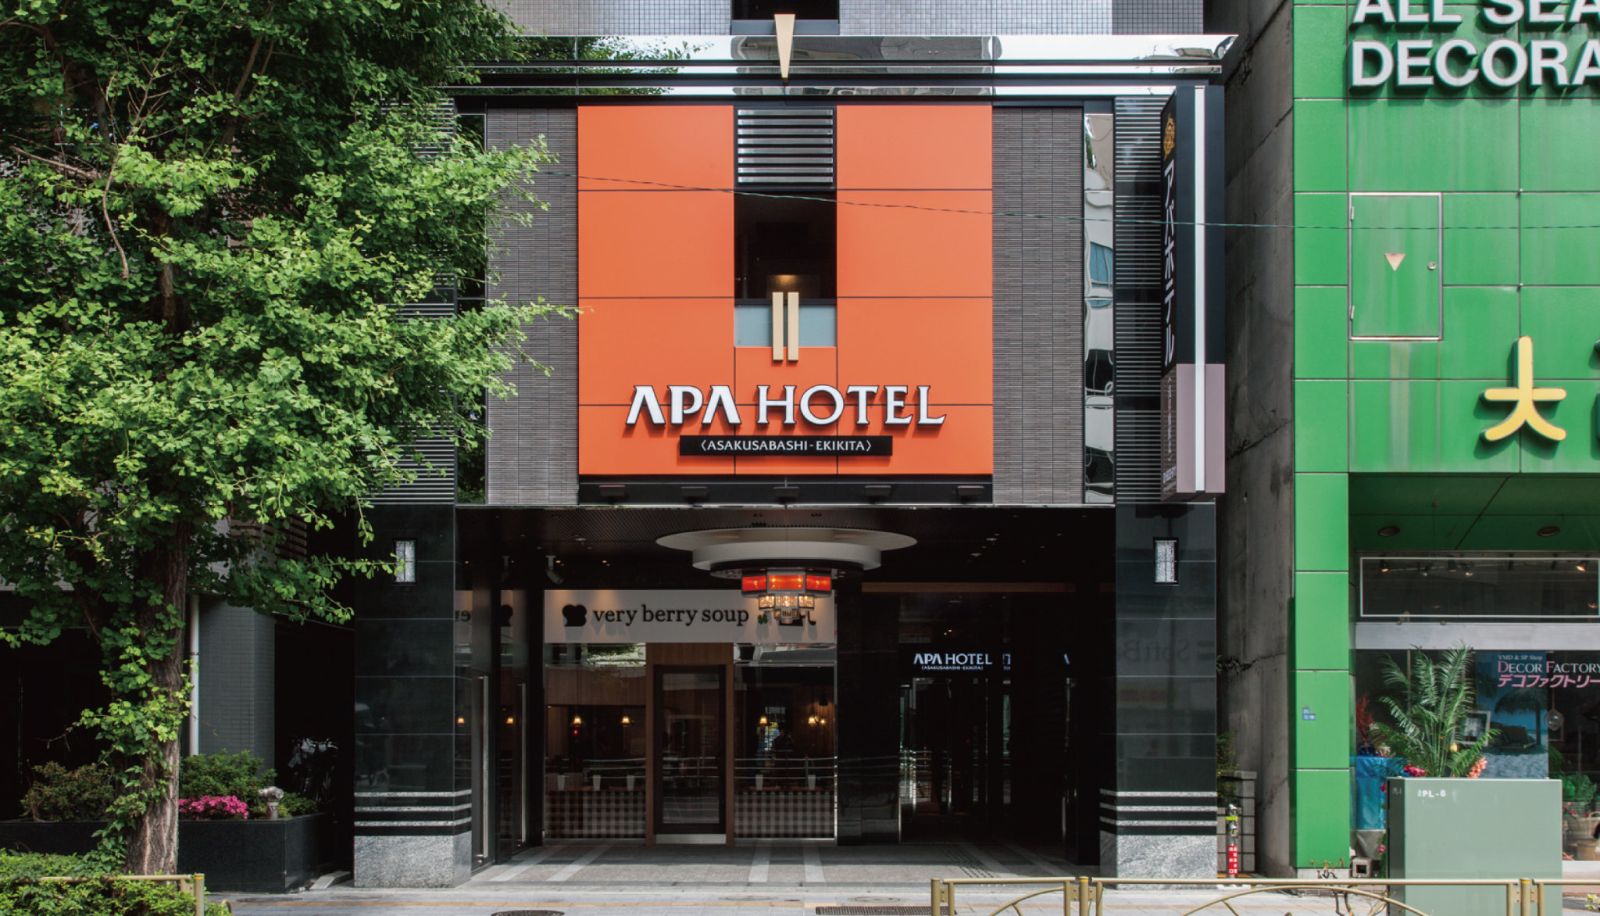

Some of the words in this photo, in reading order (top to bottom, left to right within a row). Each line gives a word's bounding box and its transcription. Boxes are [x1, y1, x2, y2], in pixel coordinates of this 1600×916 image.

[625, 384, 742, 426] APA
[756, 384, 947, 426] HOTEL
[593, 608, 638, 626] very
[642, 604, 698, 626] berry
[701, 609, 749, 626] soup
[913, 653, 943, 665] APA
[945, 653, 993, 665] HOTEL
[1497, 661, 1543, 673] DECOR
[1546, 661, 1600, 673] FACTORY
[1497, 674, 1600, 688] デコファクトリー
